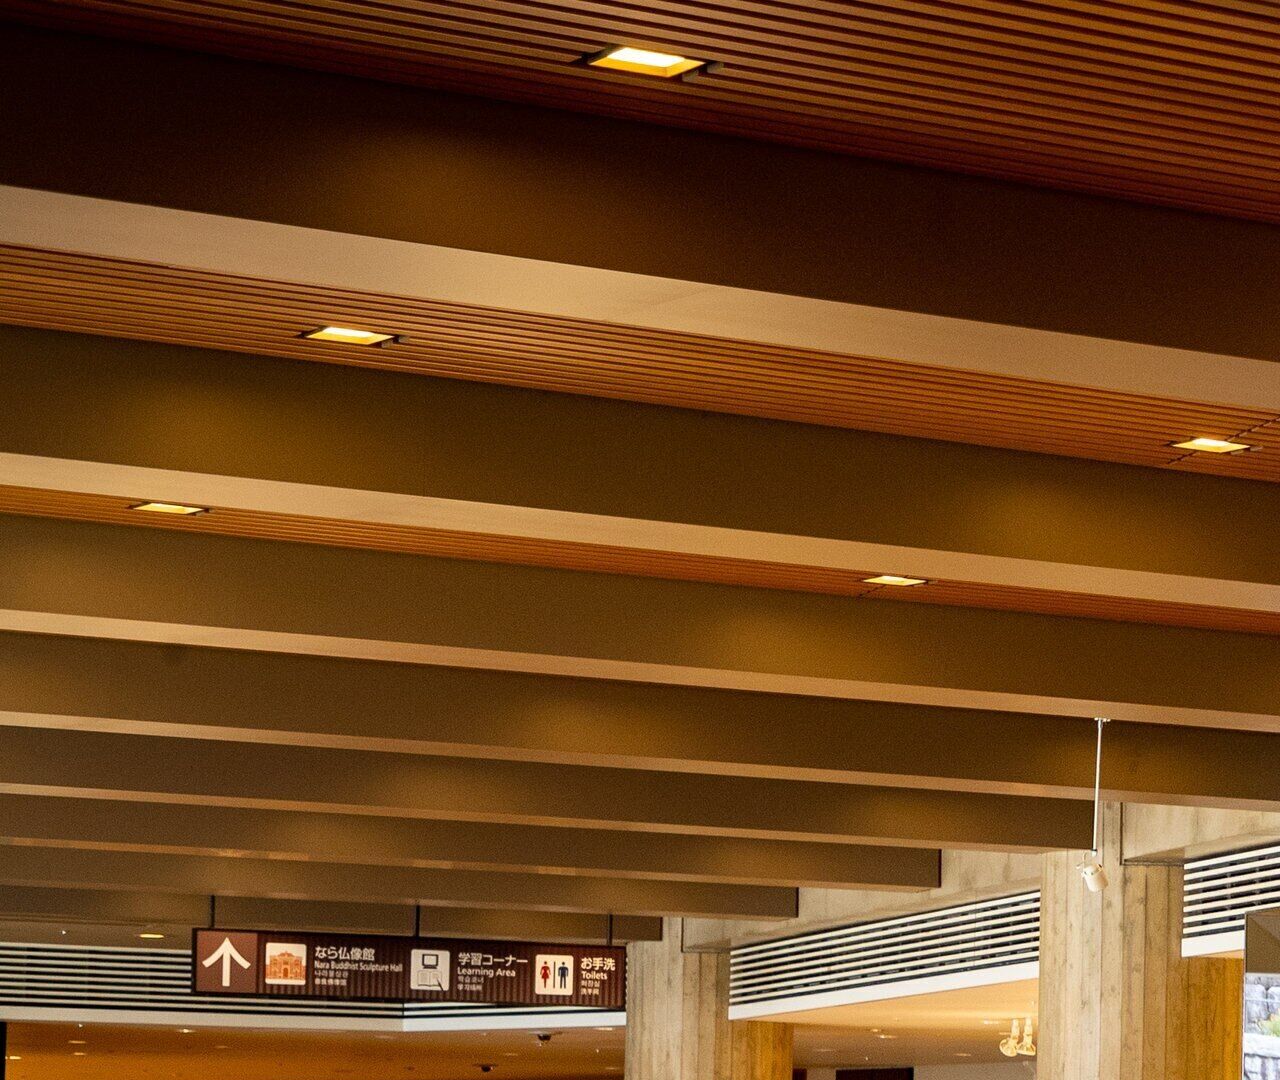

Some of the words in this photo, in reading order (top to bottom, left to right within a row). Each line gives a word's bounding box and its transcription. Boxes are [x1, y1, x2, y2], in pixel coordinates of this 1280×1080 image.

[315, 946, 375, 961] なら仏像館
[458, 952, 528, 967] 学習コーナー
[314, 961, 330, 970] Nara
[331, 961, 359, 971] Buddhist
[359, 962, 390, 973] Sculpture
[390, 963, 403, 973] Hall
[581, 957, 616, 971] お手洗
[457, 967, 494, 979] Learning
[496, 968, 516, 978] Area
[582, 971, 608, 980] Toilets
